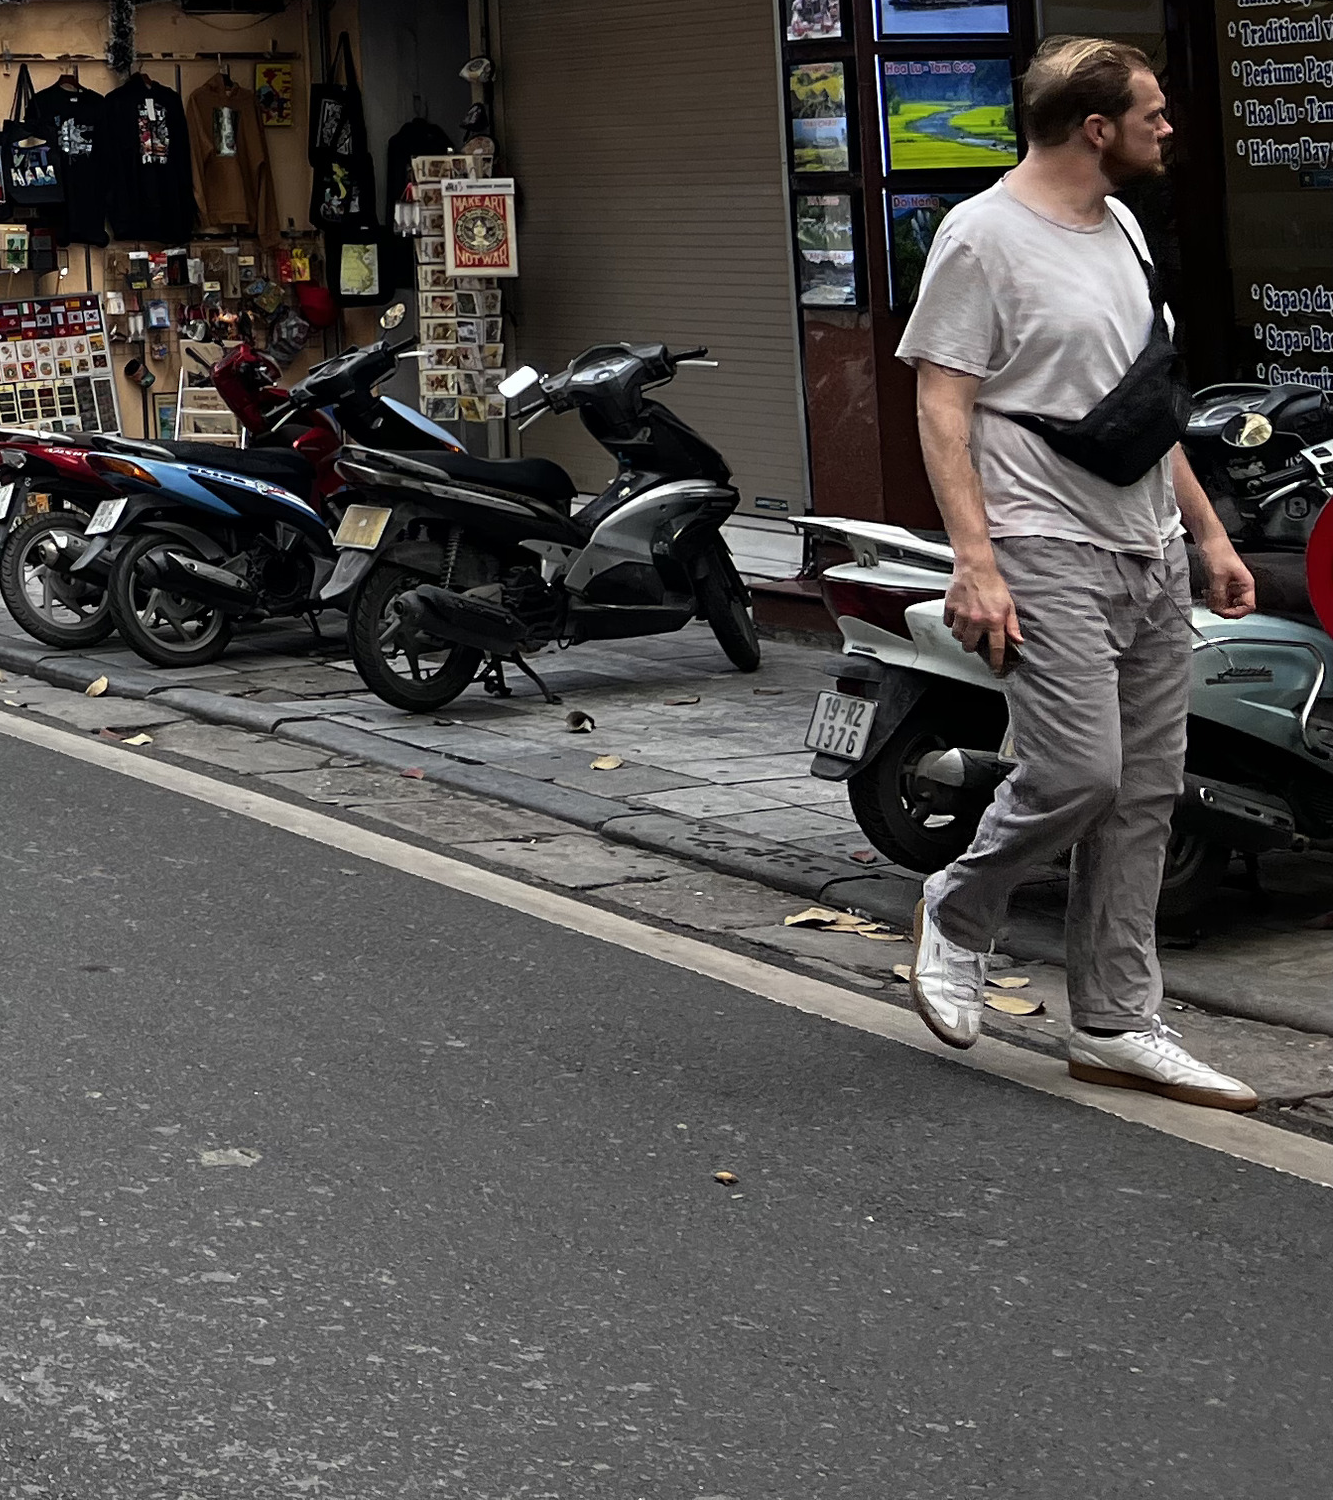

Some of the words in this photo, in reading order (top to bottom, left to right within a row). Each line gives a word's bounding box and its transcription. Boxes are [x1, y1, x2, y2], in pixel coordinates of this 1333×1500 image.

[1240, 14, 1322, 47] Traditional
[885, 62, 908, 75] Hoa
[954, 61, 976, 74] Coc
[1242, 58, 1304, 87] Perfume
[1245, 98, 1275, 127] Hoa
[1276, 97, 1297, 124] Lu
[1248, 138, 1301, 170] Halong
[1302, 136, 1330, 170] Bay
[453, 195, 482, 218] MAKE
[484, 195, 505, 216] ART
[455, 244, 480, 266] NOT
[482, 243, 509, 266] WAR
[1263, 283, 1299, 317] Sapa
[1300, 288, 1313, 313] 2
[1266, 323, 1303, 357] Sapa
[823, 695, 866, 728] 19-R2
[815, 722, 859, 755] 1376
